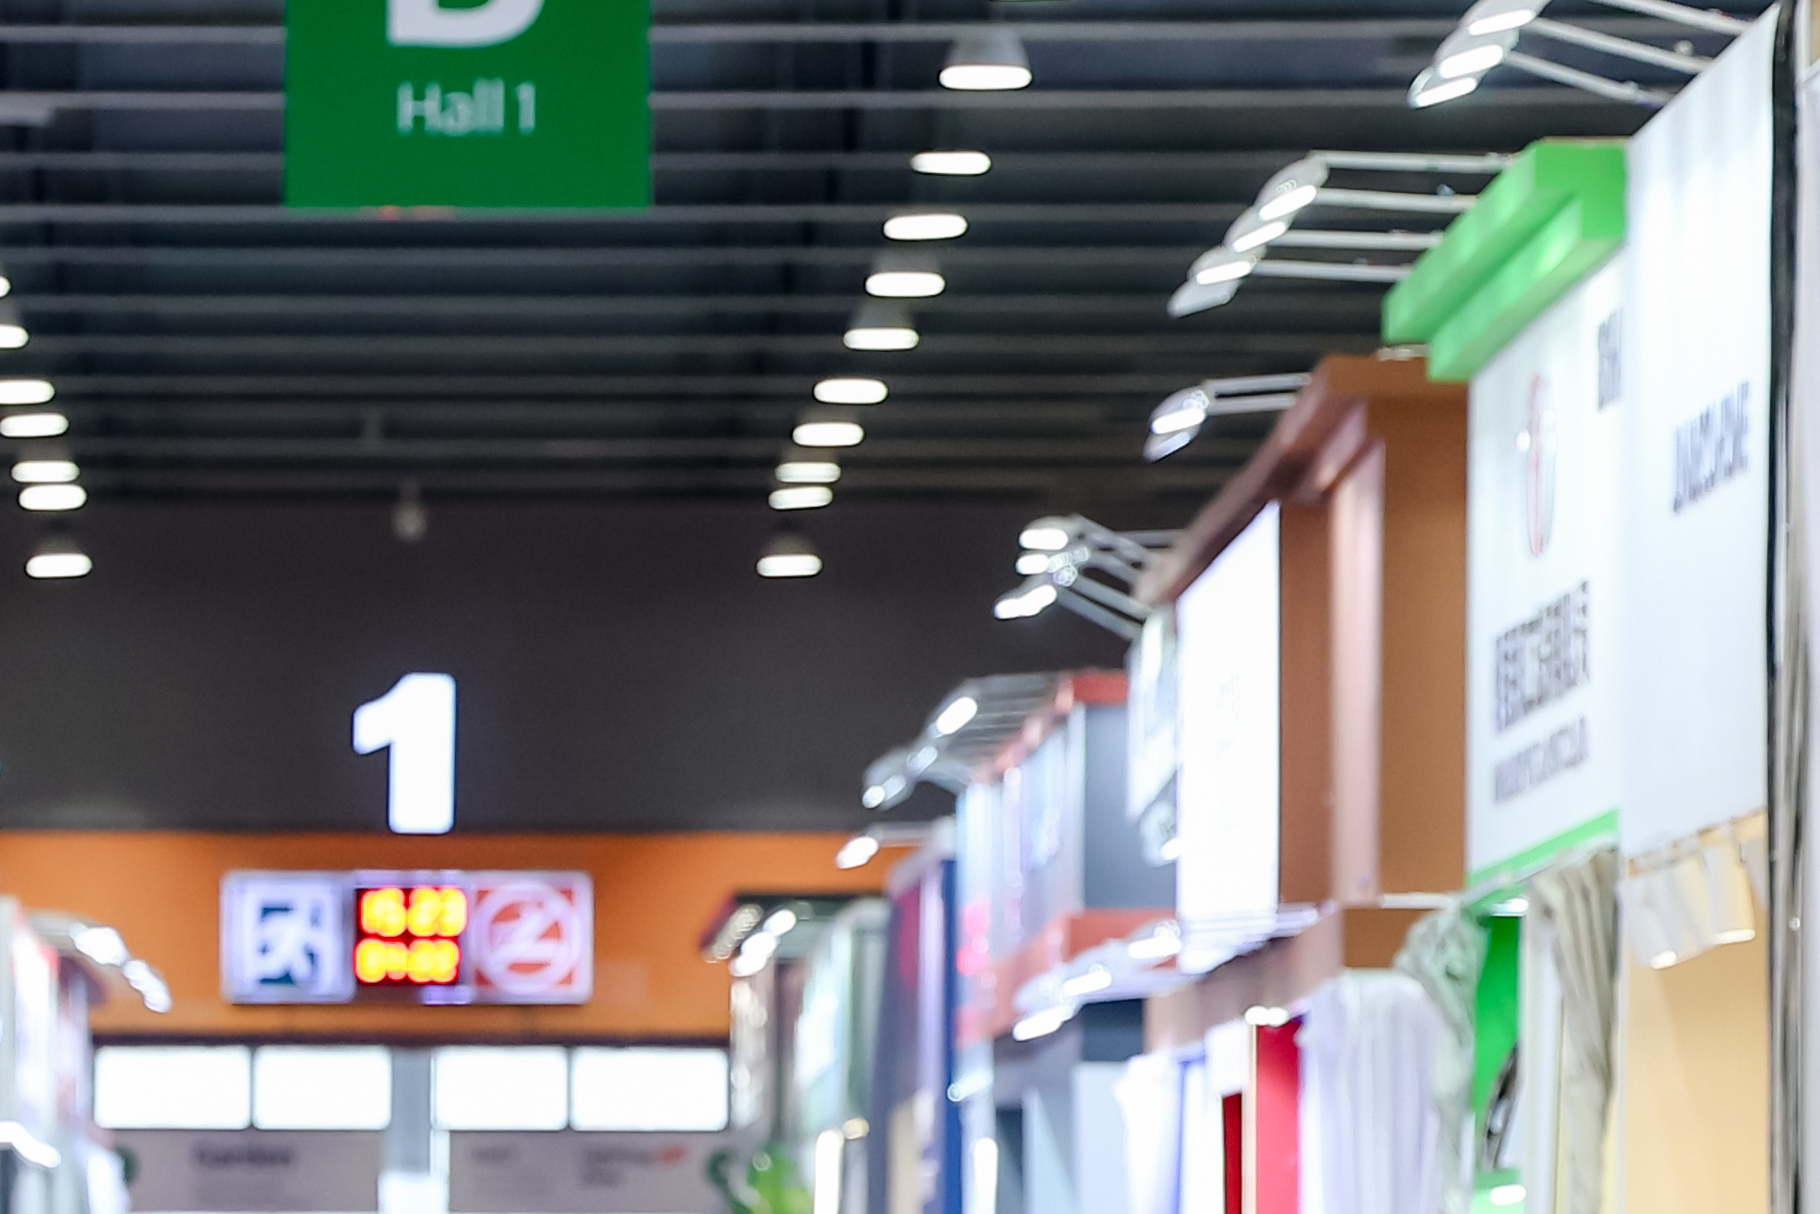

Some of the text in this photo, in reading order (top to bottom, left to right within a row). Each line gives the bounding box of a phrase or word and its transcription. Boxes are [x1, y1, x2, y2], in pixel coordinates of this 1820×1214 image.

[396, 78, 536, 136] Hall 1
[352, 671, 457, 834] 1
